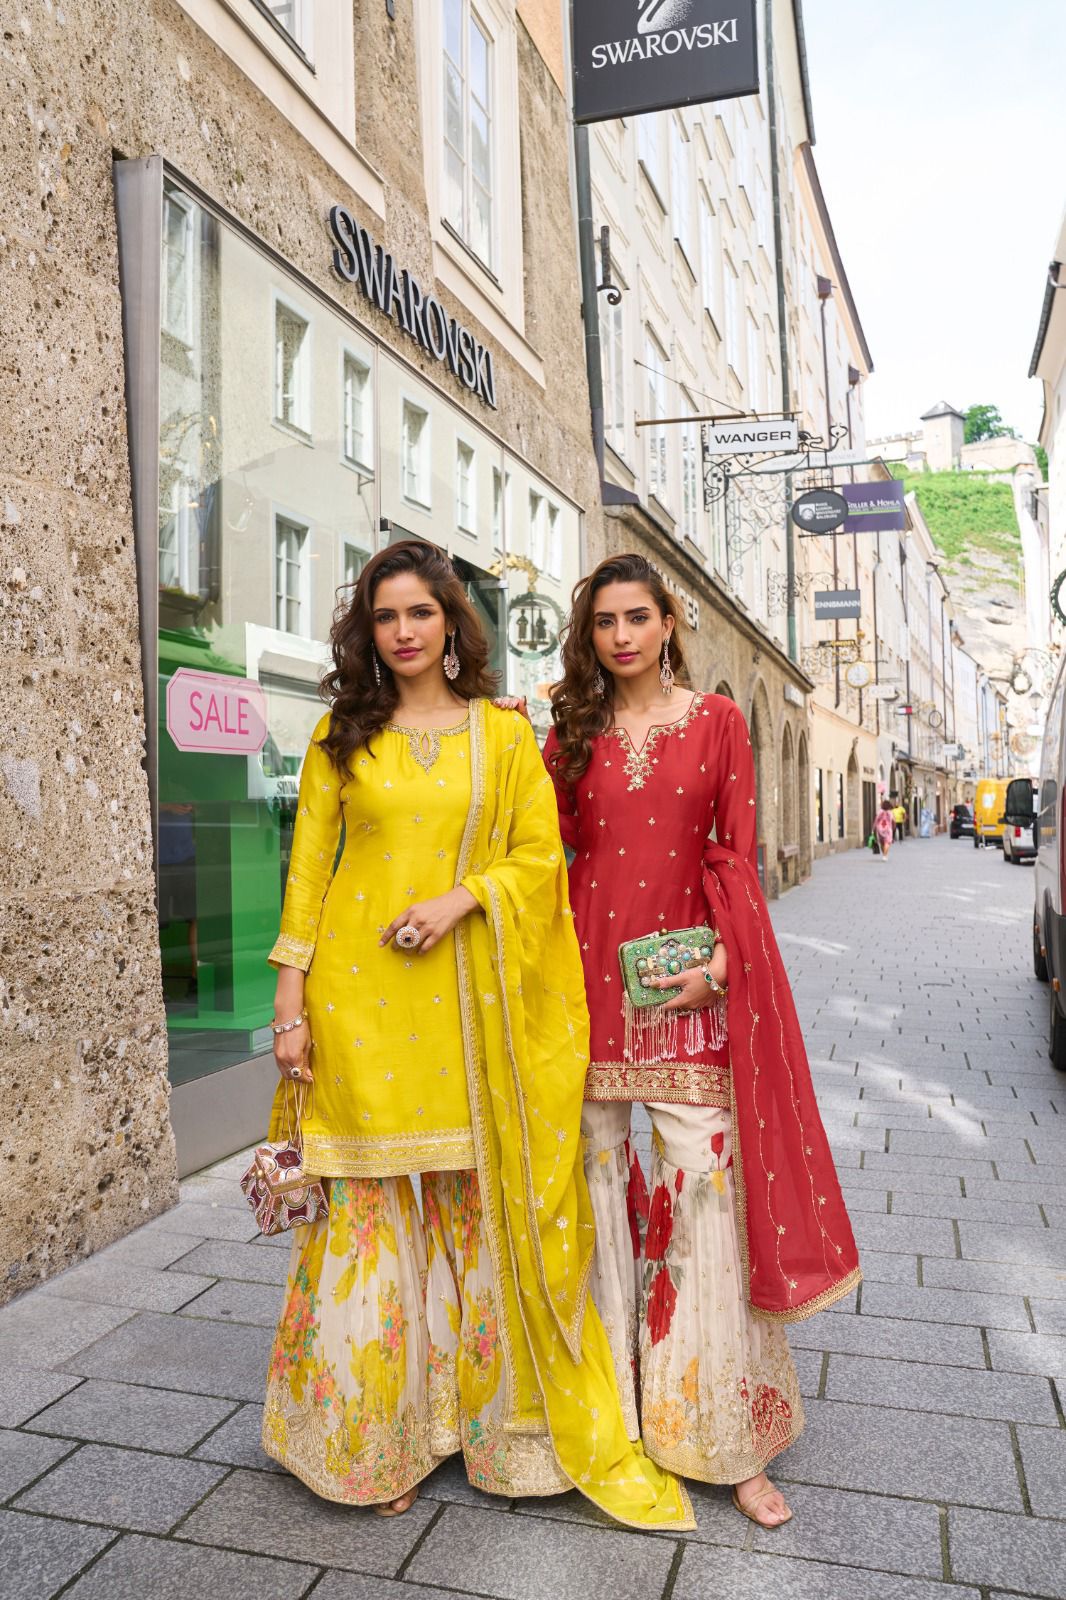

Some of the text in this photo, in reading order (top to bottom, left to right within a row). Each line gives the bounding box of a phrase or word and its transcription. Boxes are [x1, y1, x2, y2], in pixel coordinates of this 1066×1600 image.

[591, 18, 739, 69] SWAROVSKI
[329, 204, 497, 410] SWAROVSKI
[714, 430, 792, 444] WANGER
[189, 691, 249, 735] SALE
